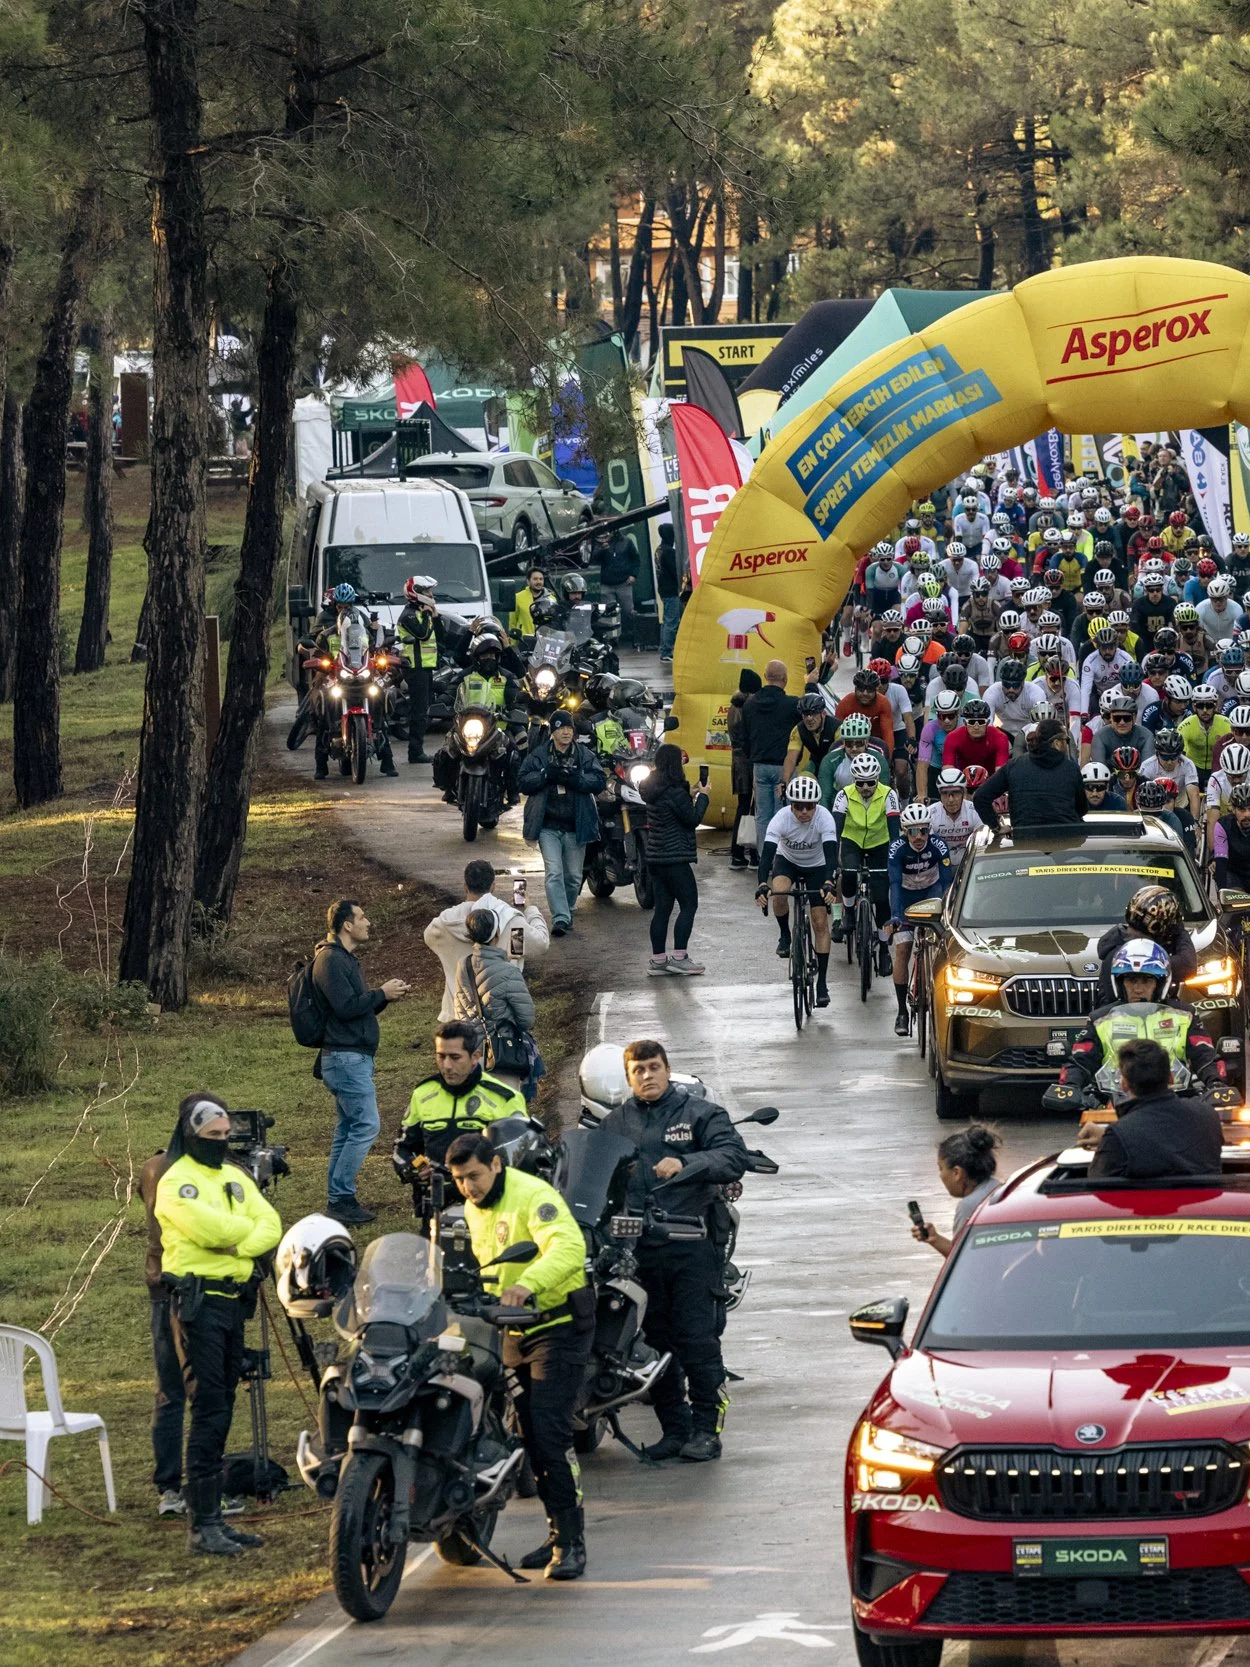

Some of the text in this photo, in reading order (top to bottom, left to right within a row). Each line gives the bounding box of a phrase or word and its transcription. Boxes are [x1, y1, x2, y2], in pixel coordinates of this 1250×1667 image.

[1060, 309, 1212, 366] Asperox
[719, 345, 755, 359] START
[354, 410, 397, 421] SKO
[797, 357, 946, 480] EN ÇOK TERCİH EDİLEN
[814, 383, 984, 526] SPREY TEMİZLİK MARKASI
[730, 548, 808, 572] Asperox
[633, 736, 642, 748] F
[978, 871, 1012, 880] SKODA
[1125, 867, 1160, 875] DIRECTOR
[1192, 998, 1239, 1012] KODA
[945, 1006, 1002, 1019] SKODA
[1071, 1224, 1103, 1234] YARIŞ
[1106, 1222, 1175, 1233] DİREKTÖRÜ
[1187, 1224, 1217, 1233] RACE
[975, 1230, 1032, 1245] SKODA
[851, 1494, 941, 1513] SKODA
[1056, 1550, 1128, 1562] SKODA
